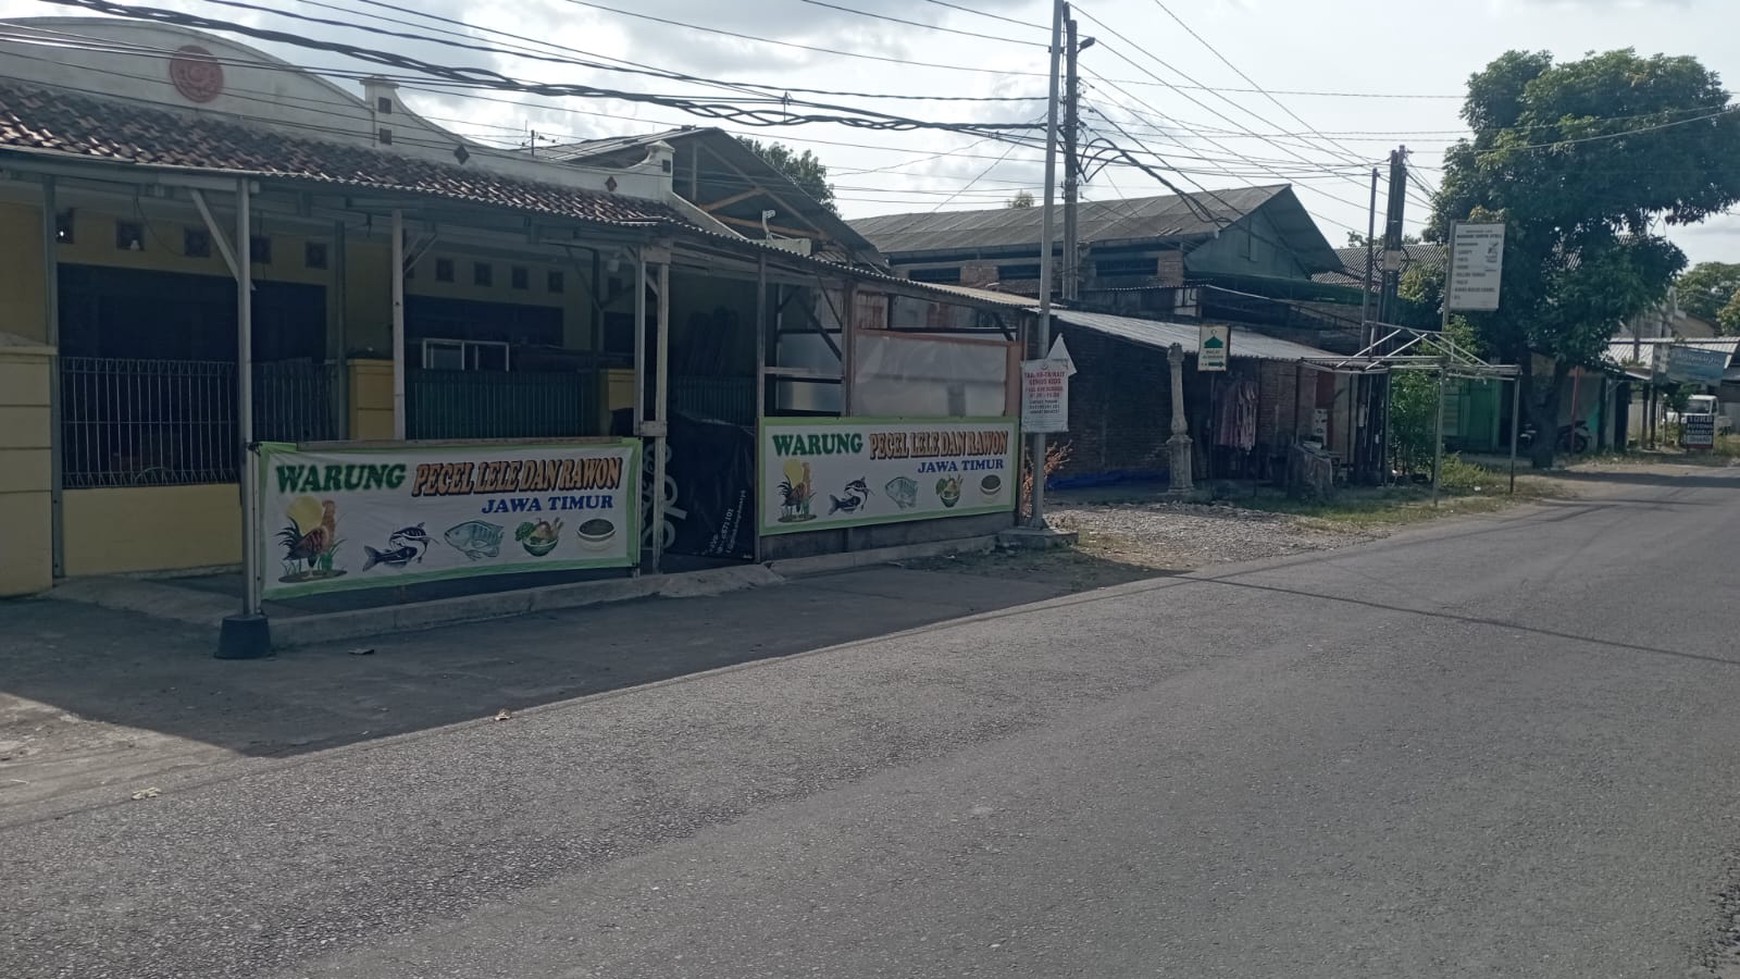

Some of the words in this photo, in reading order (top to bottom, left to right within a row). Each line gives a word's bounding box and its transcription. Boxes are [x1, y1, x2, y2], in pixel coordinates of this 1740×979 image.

[772, 432, 863, 457] WARUNG
[869, 432, 909, 460] PECEL
[910, 431, 940, 458] LELE
[940, 431, 966, 457] DAN
[966, 430, 1008, 456] RAWON
[275, 463, 406, 493] WARUNG
[411, 462, 475, 497] PECEL
[473, 460, 521, 494] LELE
[518, 460, 562, 492] DAN
[559, 457, 623, 491] RAWON
[917, 460, 958, 473] JAWA
[961, 459, 1003, 471] TIMUR
[481, 498, 542, 514] JAWA
[547, 495, 614, 510] TIMUR
